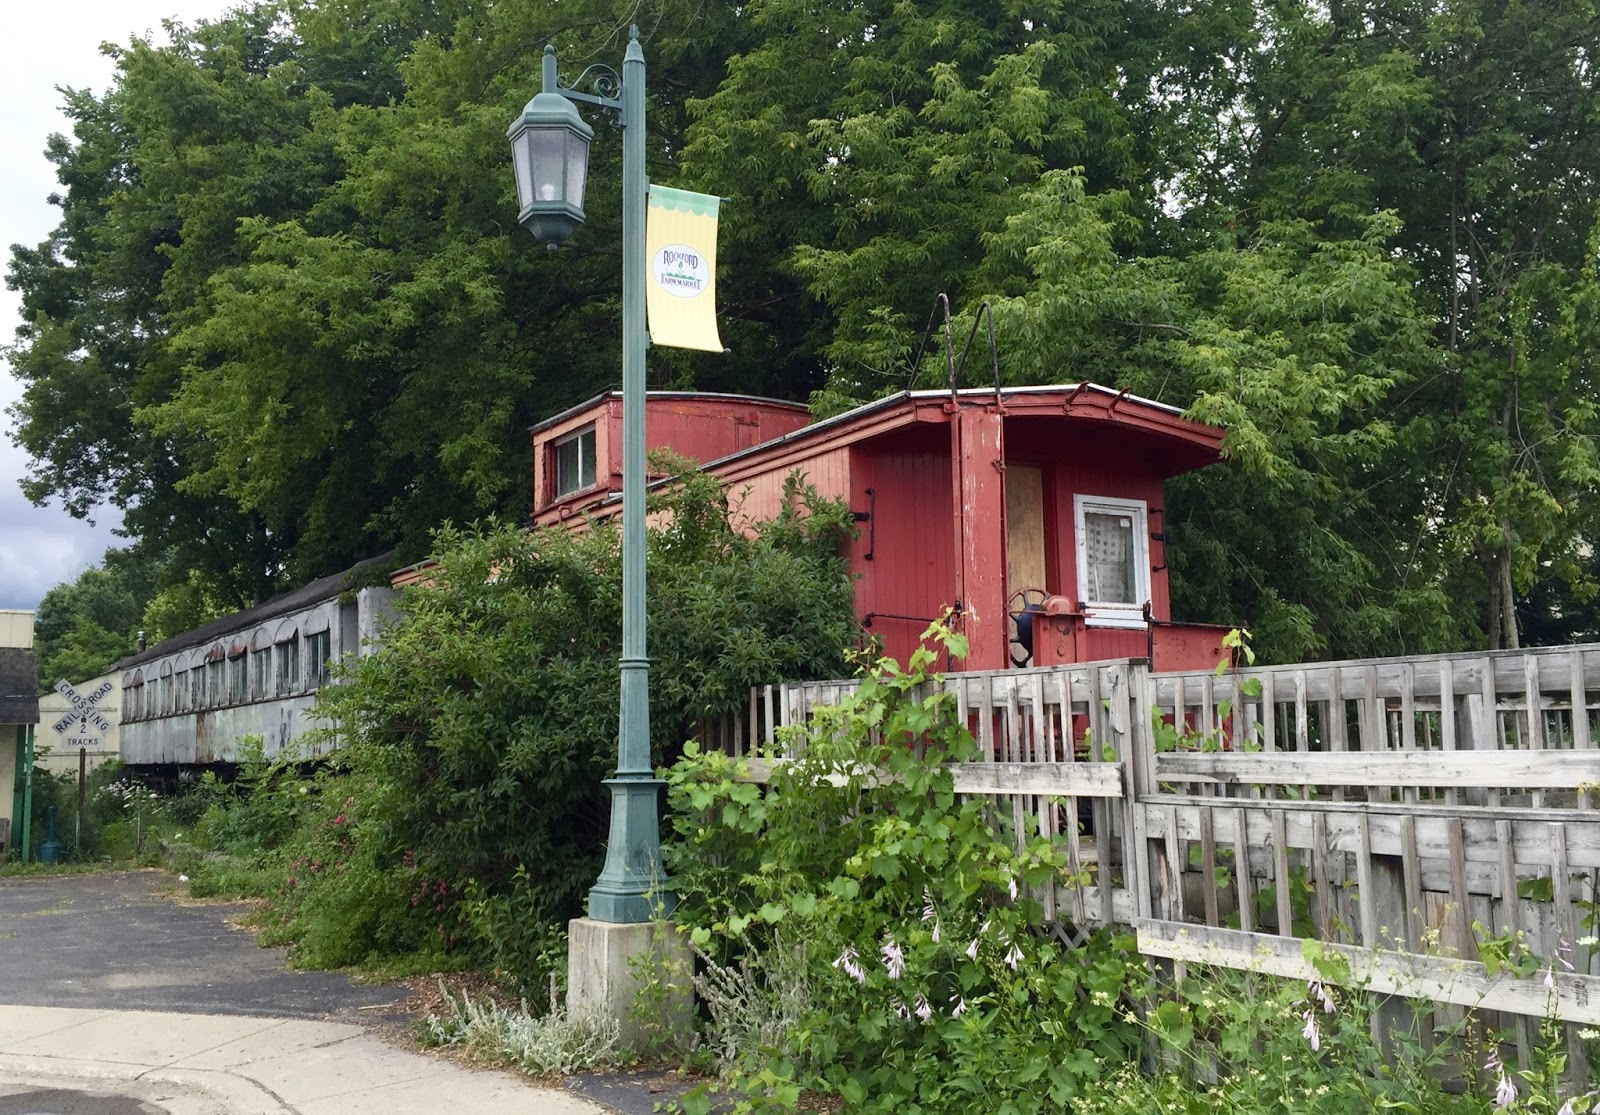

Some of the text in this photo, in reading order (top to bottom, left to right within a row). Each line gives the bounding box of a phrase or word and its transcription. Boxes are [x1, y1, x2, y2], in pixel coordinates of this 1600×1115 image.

[663, 250, 698, 269] ROCKFORD
[60, 684, 109, 731] CROSSING
[80, 723, 86, 733] 2
[67, 738, 99, 746] TRACKS
